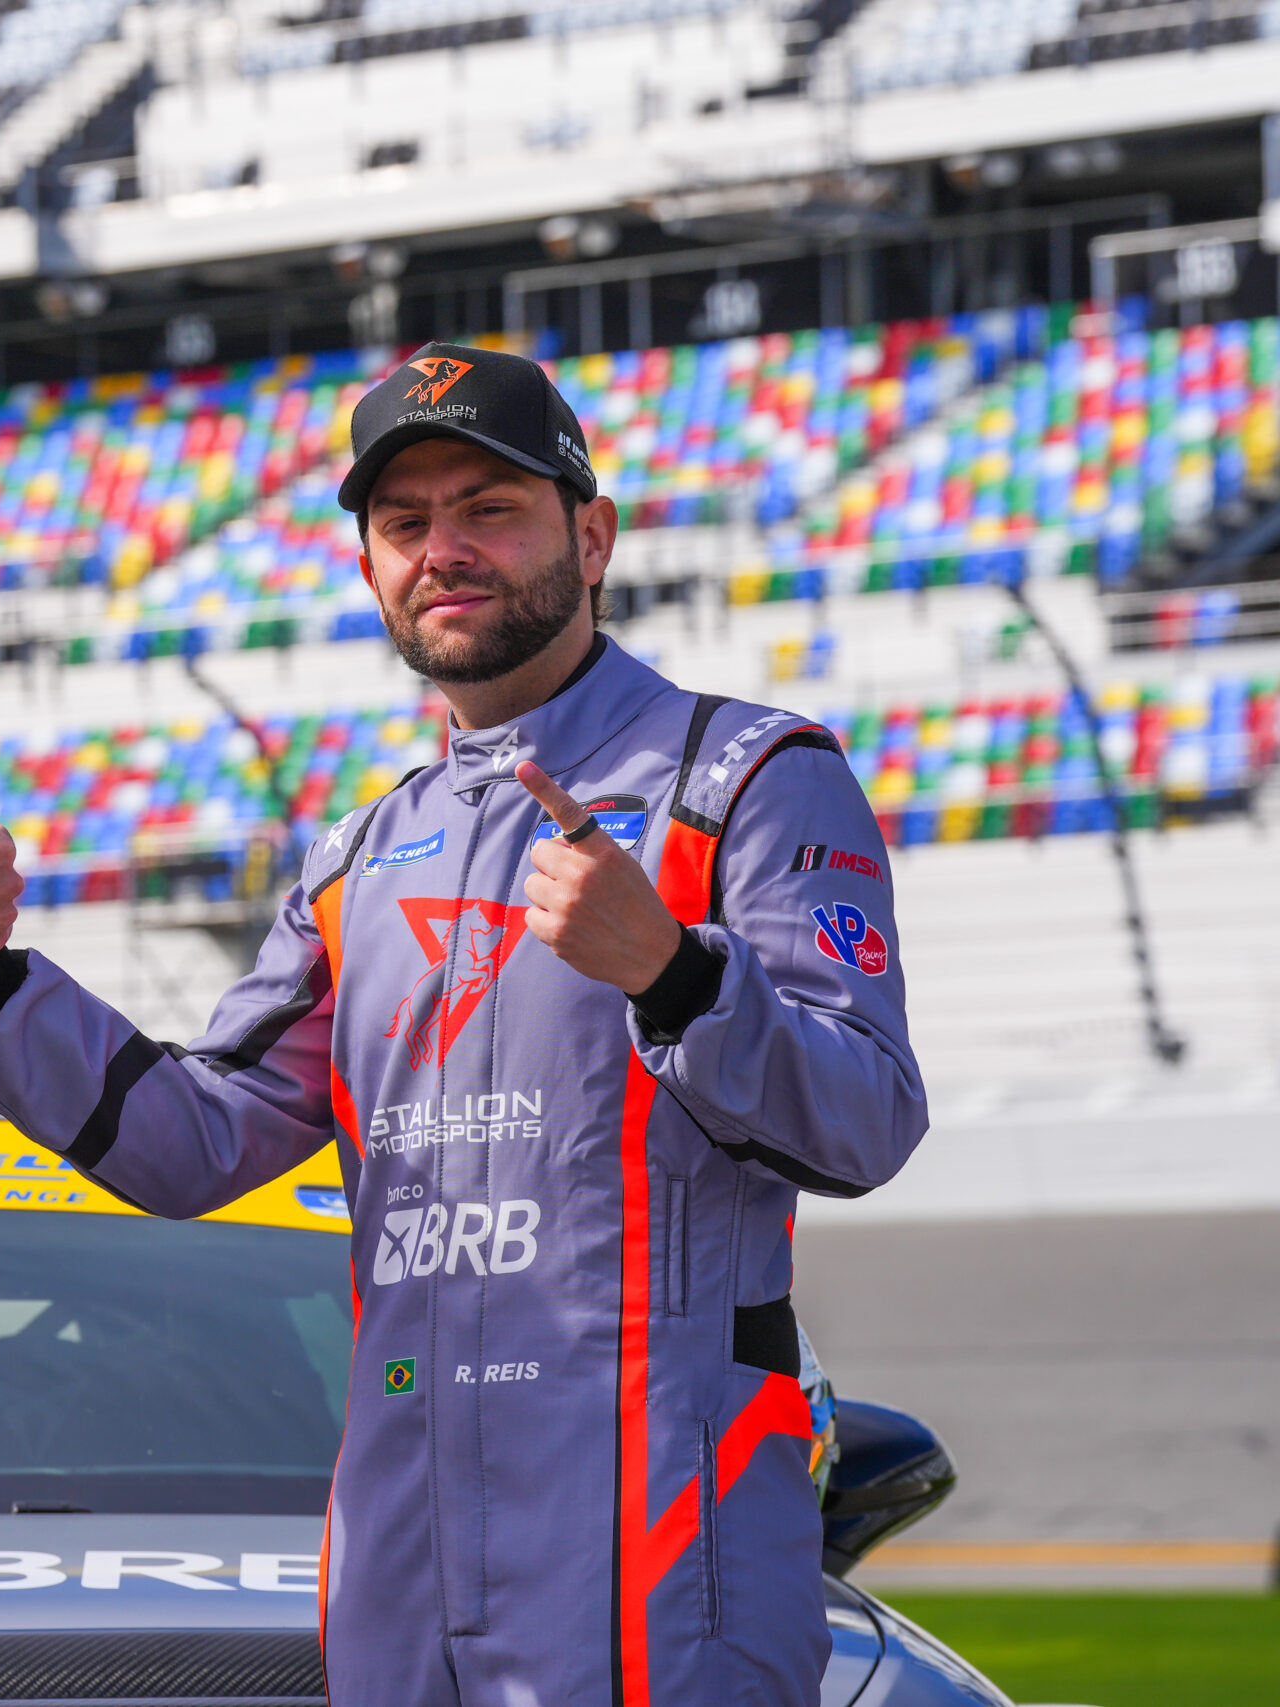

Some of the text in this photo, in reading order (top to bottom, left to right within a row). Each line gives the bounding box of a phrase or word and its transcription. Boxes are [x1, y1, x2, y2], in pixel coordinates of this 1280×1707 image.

[397, 404, 477, 426] STALLION
[413, 411, 477, 421] ORSPORTS
[707, 710, 799, 784] HRX
[599, 822, 628, 830] ELIN
[827, 849, 884, 883] IMSA
[810, 901, 867, 971] VP
[857, 947, 888, 967] Racing
[370, 1088, 542, 1138] STALLION
[370, 1119, 542, 1158] MOTORSPORTS
[411, 1199, 541, 1277] BRB
[454, 1361, 541, 1383] R. REIS
